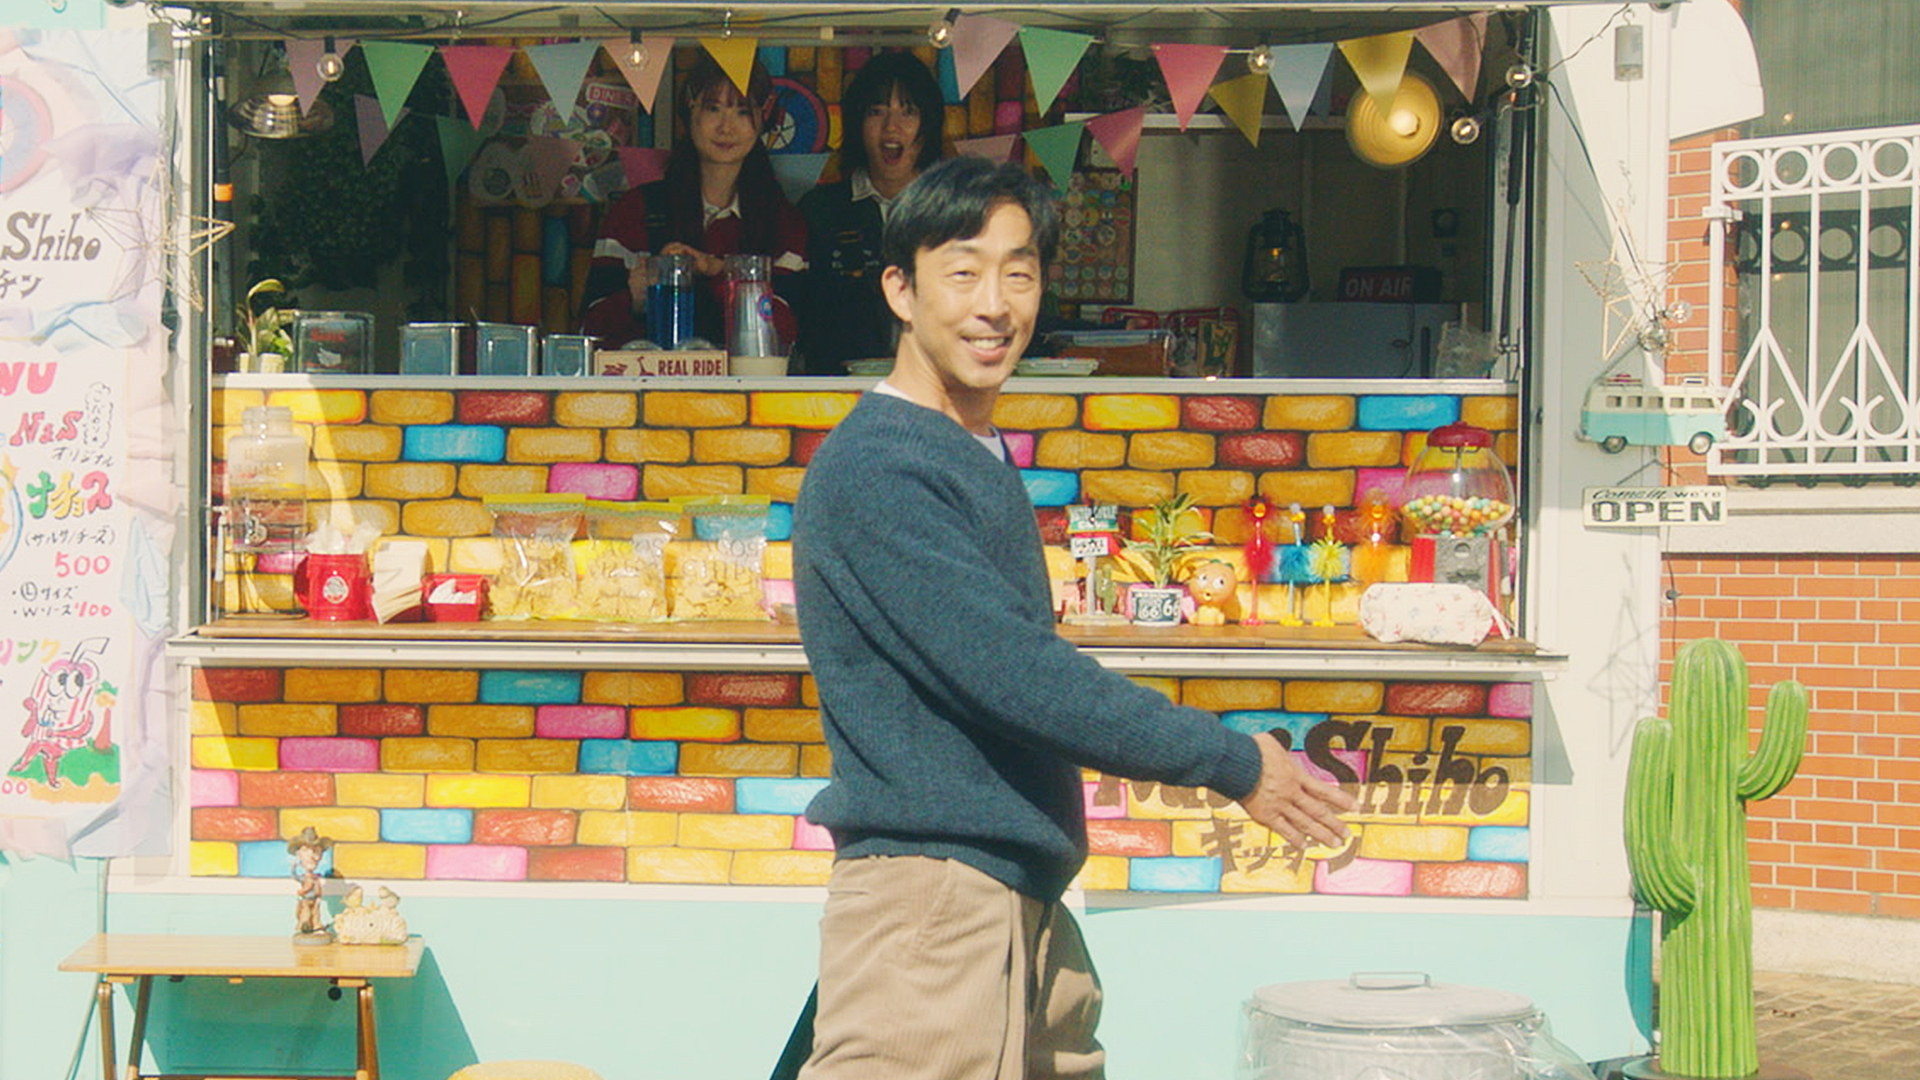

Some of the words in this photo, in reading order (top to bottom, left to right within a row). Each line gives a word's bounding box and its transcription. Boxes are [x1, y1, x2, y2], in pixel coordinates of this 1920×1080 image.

[1, 211, 101, 262] Shiho
[1346, 276, 1374, 298] ON
[1379, 276, 1412, 297] AIR
[657, 359, 688, 376] REAL
[692, 359, 722, 376] RIDE
[1592, 501, 1721, 522] OPEN
[55, 551, 111, 578] 500
[1304, 720, 1510, 816] Shiho
